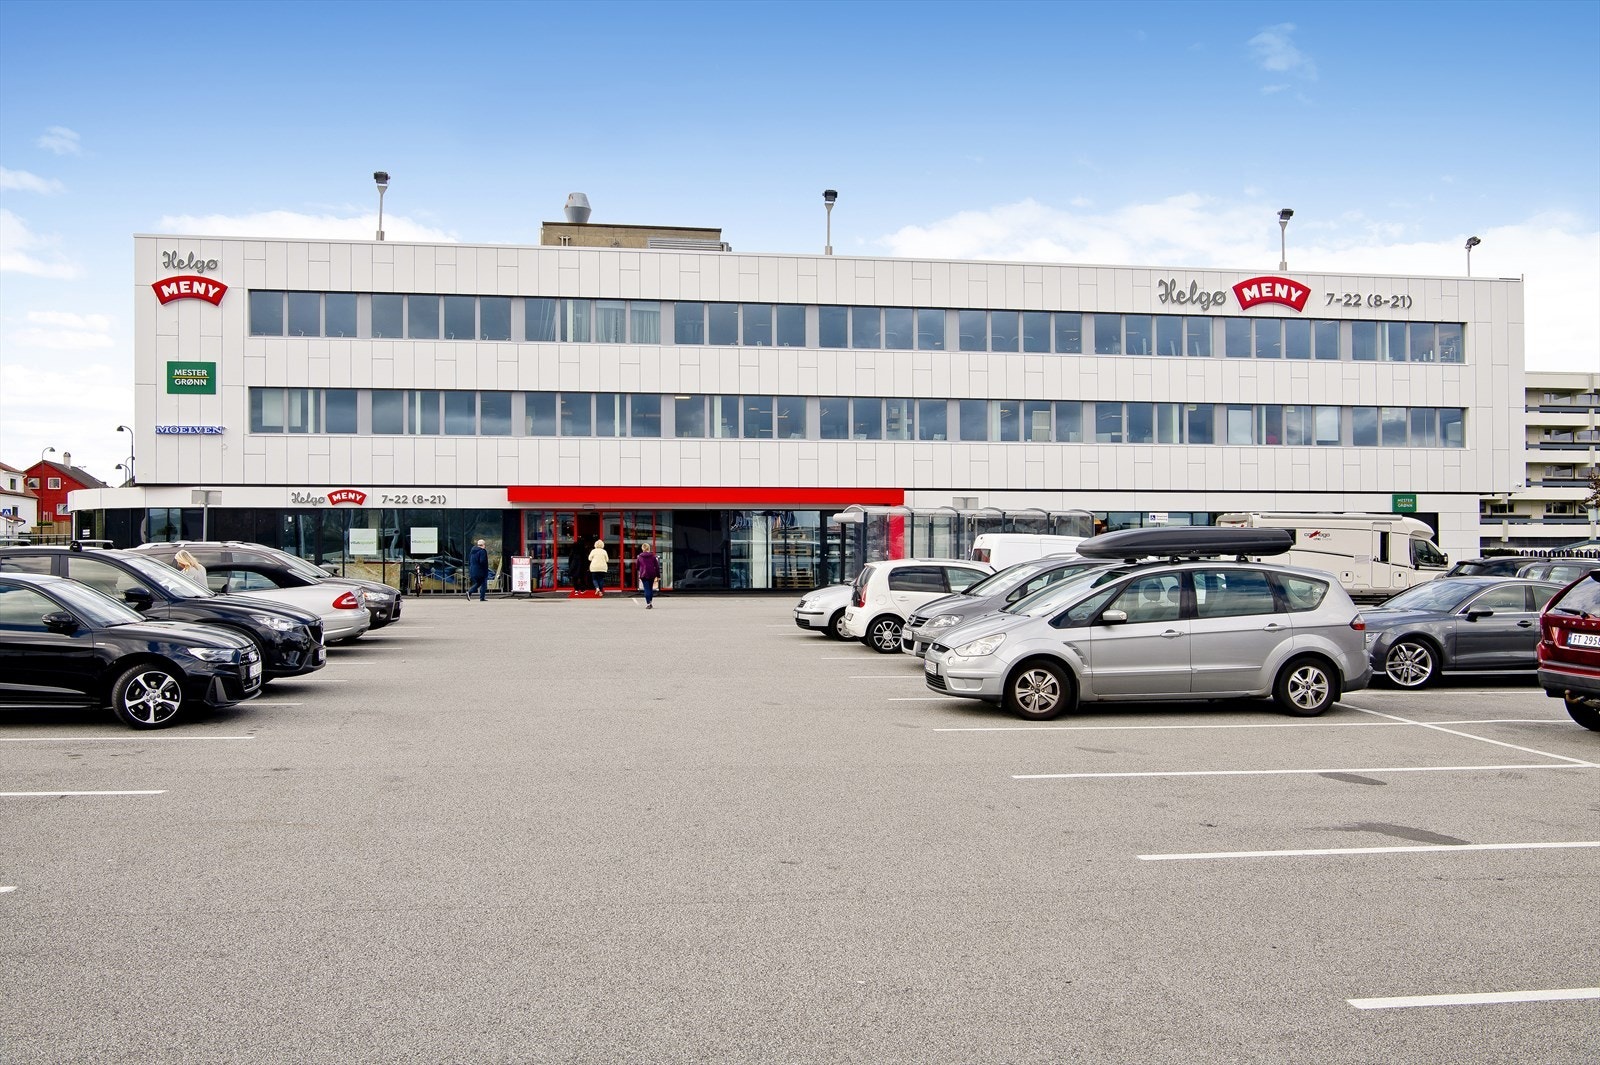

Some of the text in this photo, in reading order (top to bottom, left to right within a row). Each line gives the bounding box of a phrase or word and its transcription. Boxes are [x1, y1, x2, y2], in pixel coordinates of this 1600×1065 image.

[162, 250, 219, 274] Helgø
[161, 281, 220, 297] MENY
[1158, 278, 1413, 311] Helgø MENY 7-22 (8-21)
[155, 425, 224, 435] MOELVEN
[291, 491, 447, 506] Helgø MENY 7-22 (8-21)
[1573, 634, 1582, 644] FT
